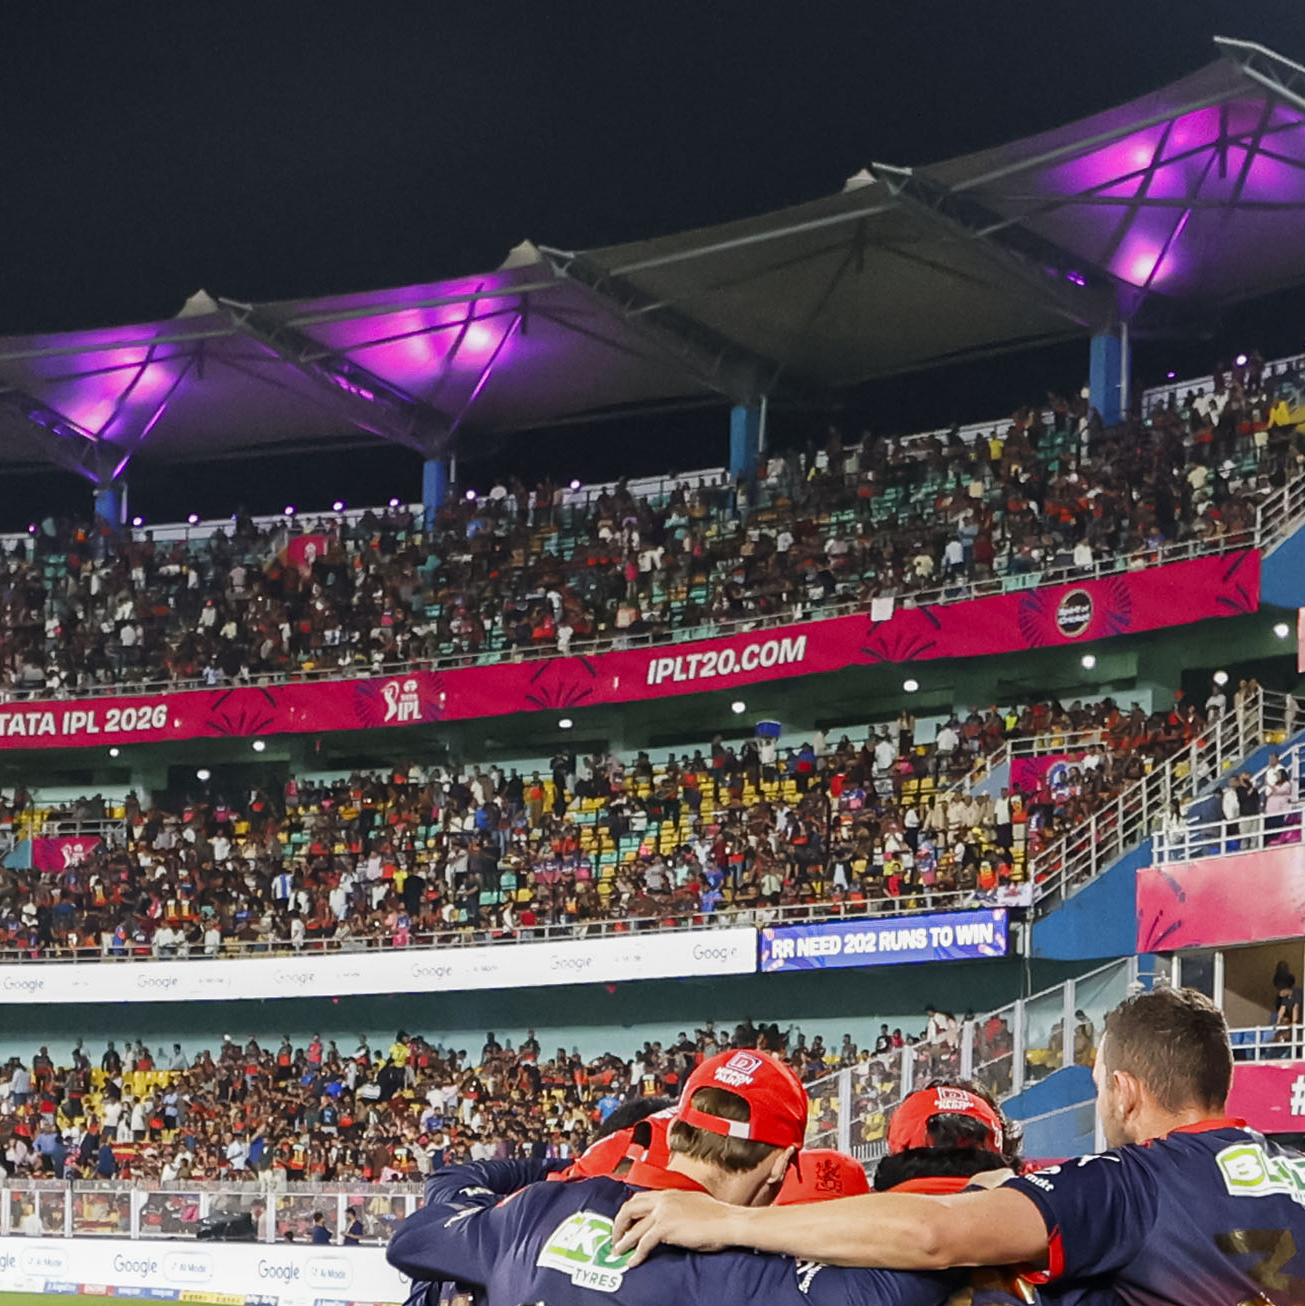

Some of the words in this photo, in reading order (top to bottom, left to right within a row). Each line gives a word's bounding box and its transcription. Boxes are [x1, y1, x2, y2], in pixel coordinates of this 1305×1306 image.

[646, 635, 808, 686] IPLT20.COM
[62, 711, 99, 735] IPL
[106, 704, 168, 733] 2026
[398, 701, 422, 721] IPL
[693, 943, 738, 962] Googe
[771, 938, 794, 960] RR
[796, 934, 842, 958] NEED
[843, 932, 877, 953] 202
[878, 929, 928, 951] RUNS
[929, 927, 953, 947] TO
[955, 922, 994, 945] WIN
[3, 976, 45, 990] Google
[114, 1254, 158, 1277] Google
[259, 1259, 300, 1283] Google
[574, 1268, 618, 1289] TYRES
